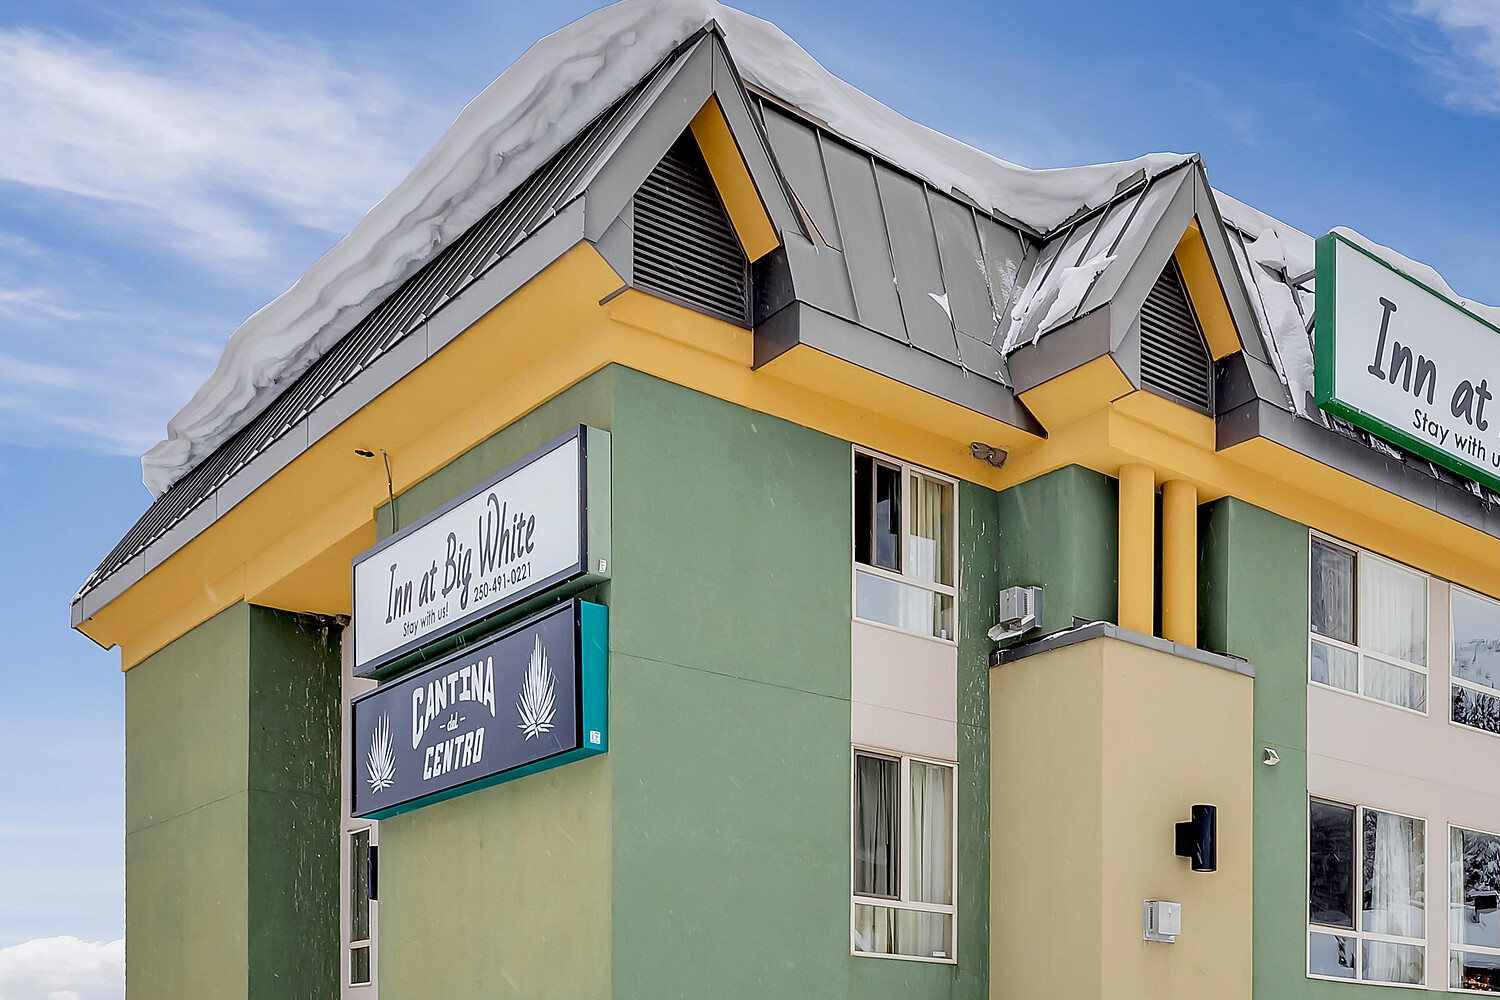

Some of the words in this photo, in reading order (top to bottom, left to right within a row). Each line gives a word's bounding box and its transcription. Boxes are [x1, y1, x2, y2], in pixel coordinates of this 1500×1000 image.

[1367, 296, 1437, 405] Inn
[1451, 378, 1492, 432] at
[1412, 408, 1450, 445] Stay
[1454, 429, 1486, 463] with
[385, 562, 412, 625] Inn
[418, 560, 438, 608] at
[441, 532, 472, 610] Big
[478, 492, 536, 578] White
[473, 561, 531, 603] 250-491-0221
[402, 616, 419, 638] Stay
[420, 610, 436, 630] with
[437, 602, 449, 622] us!
[411, 656, 496, 750] CANTINA
[423, 727, 485, 781] CENTRO
